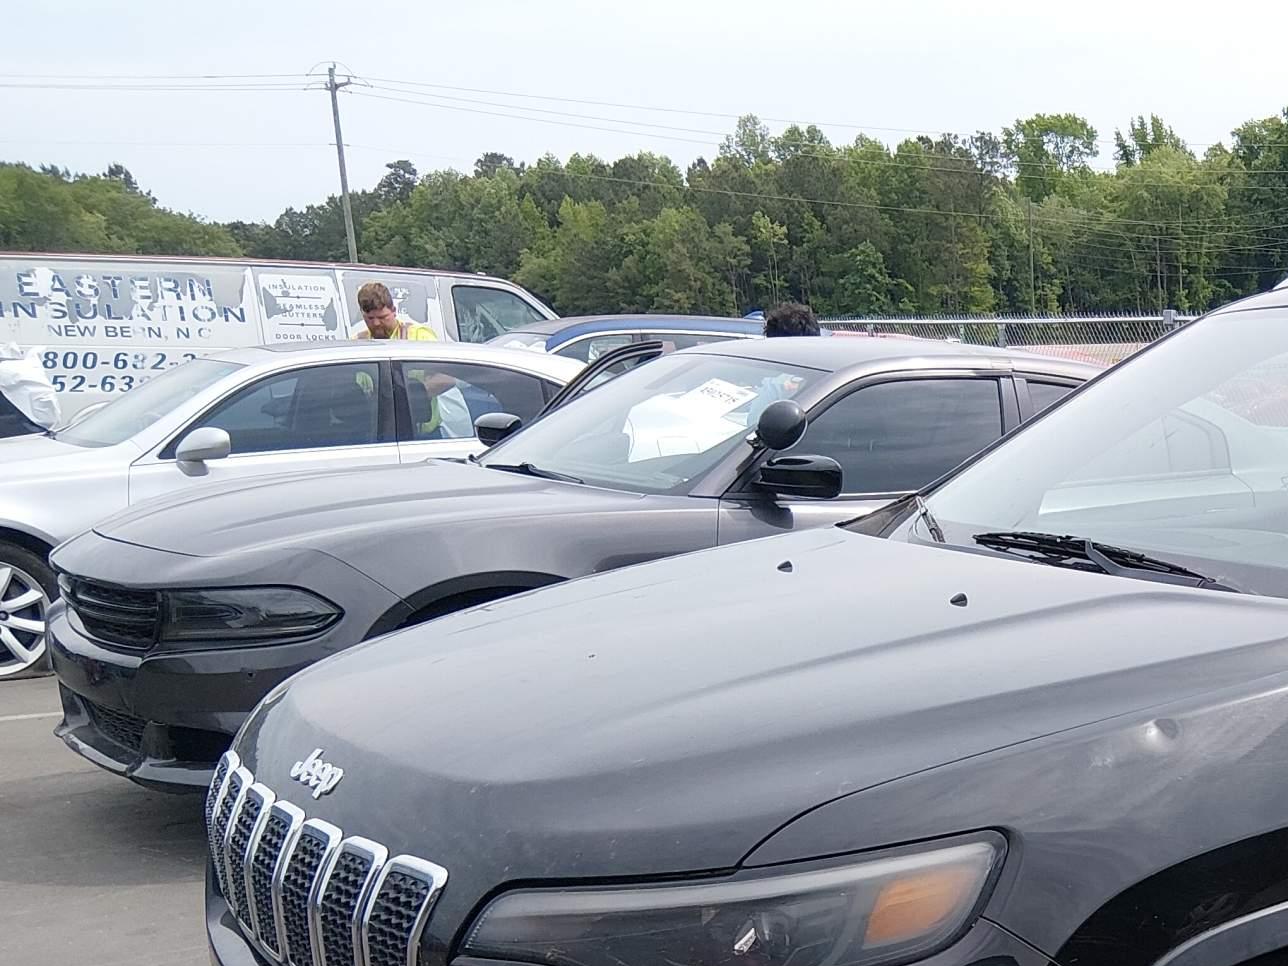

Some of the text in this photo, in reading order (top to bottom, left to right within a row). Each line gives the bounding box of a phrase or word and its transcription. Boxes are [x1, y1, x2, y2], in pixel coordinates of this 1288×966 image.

[16, 272, 214, 301] EASTERN
[279, 303, 326, 312] EAMLESS
[47, 324, 97, 337] NEW
[176, 326, 190, 339] N
[290, 748, 344, 800] Jeep
